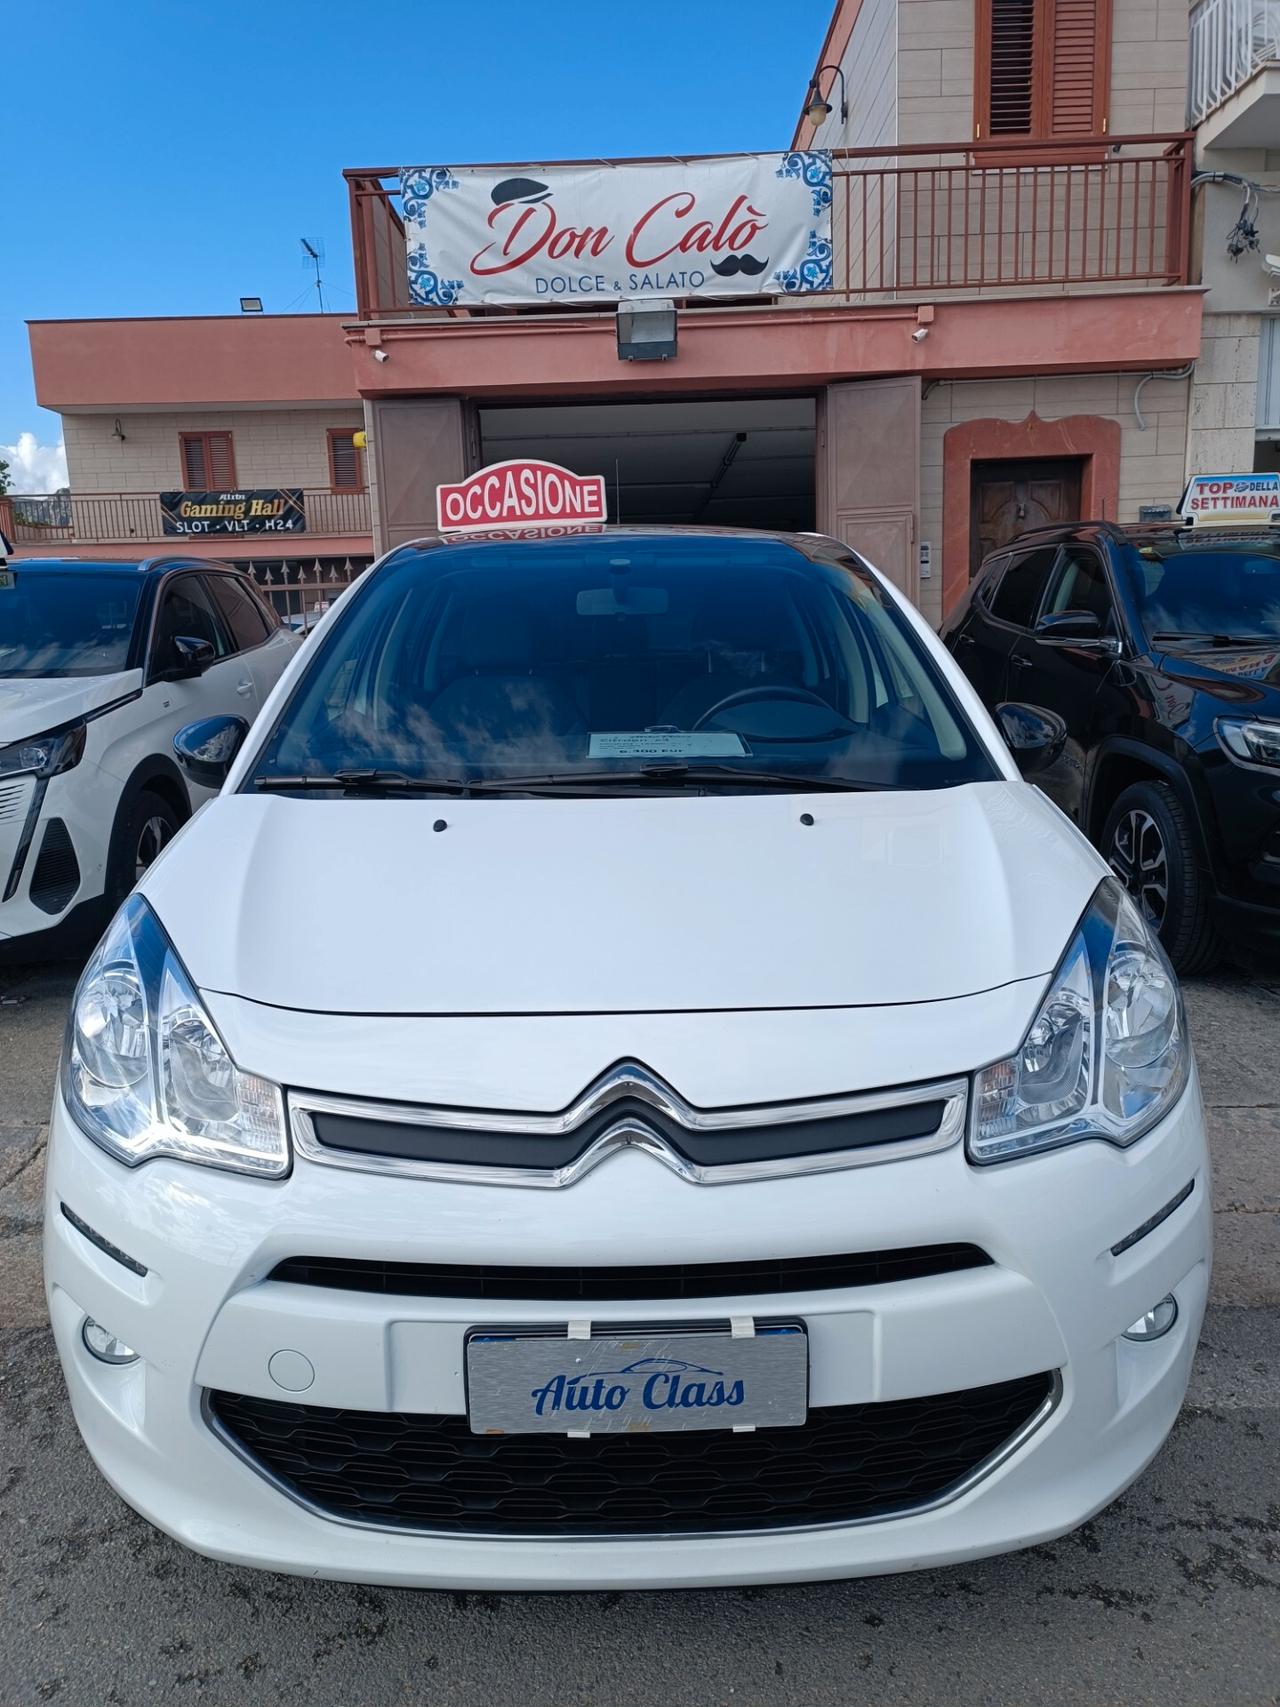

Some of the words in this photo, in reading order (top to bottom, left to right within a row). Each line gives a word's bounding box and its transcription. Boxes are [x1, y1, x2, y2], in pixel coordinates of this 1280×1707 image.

[469, 201, 615, 276] Don
[625, 191, 769, 268] Calò
[535, 275, 606, 294] DOLCE
[612, 282, 622, 292] &
[629, 270, 705, 290] SALATO
[445, 468, 600, 521] OCCASIONE
[1196, 482, 1233, 495] TOP
[1249, 481, 1279, 492] DELLA
[180, 500, 246, 520] Gaming
[249, 499, 285, 516] Hall
[1190, 495, 1280, 510] SETTIMANA
[176, 521, 211, 533] SLOT
[224, 520, 250, 532] VLT
[265, 519, 294, 530] H24
[531, 1374, 631, 1416] Auto
[642, 1373, 745, 1410] Class
